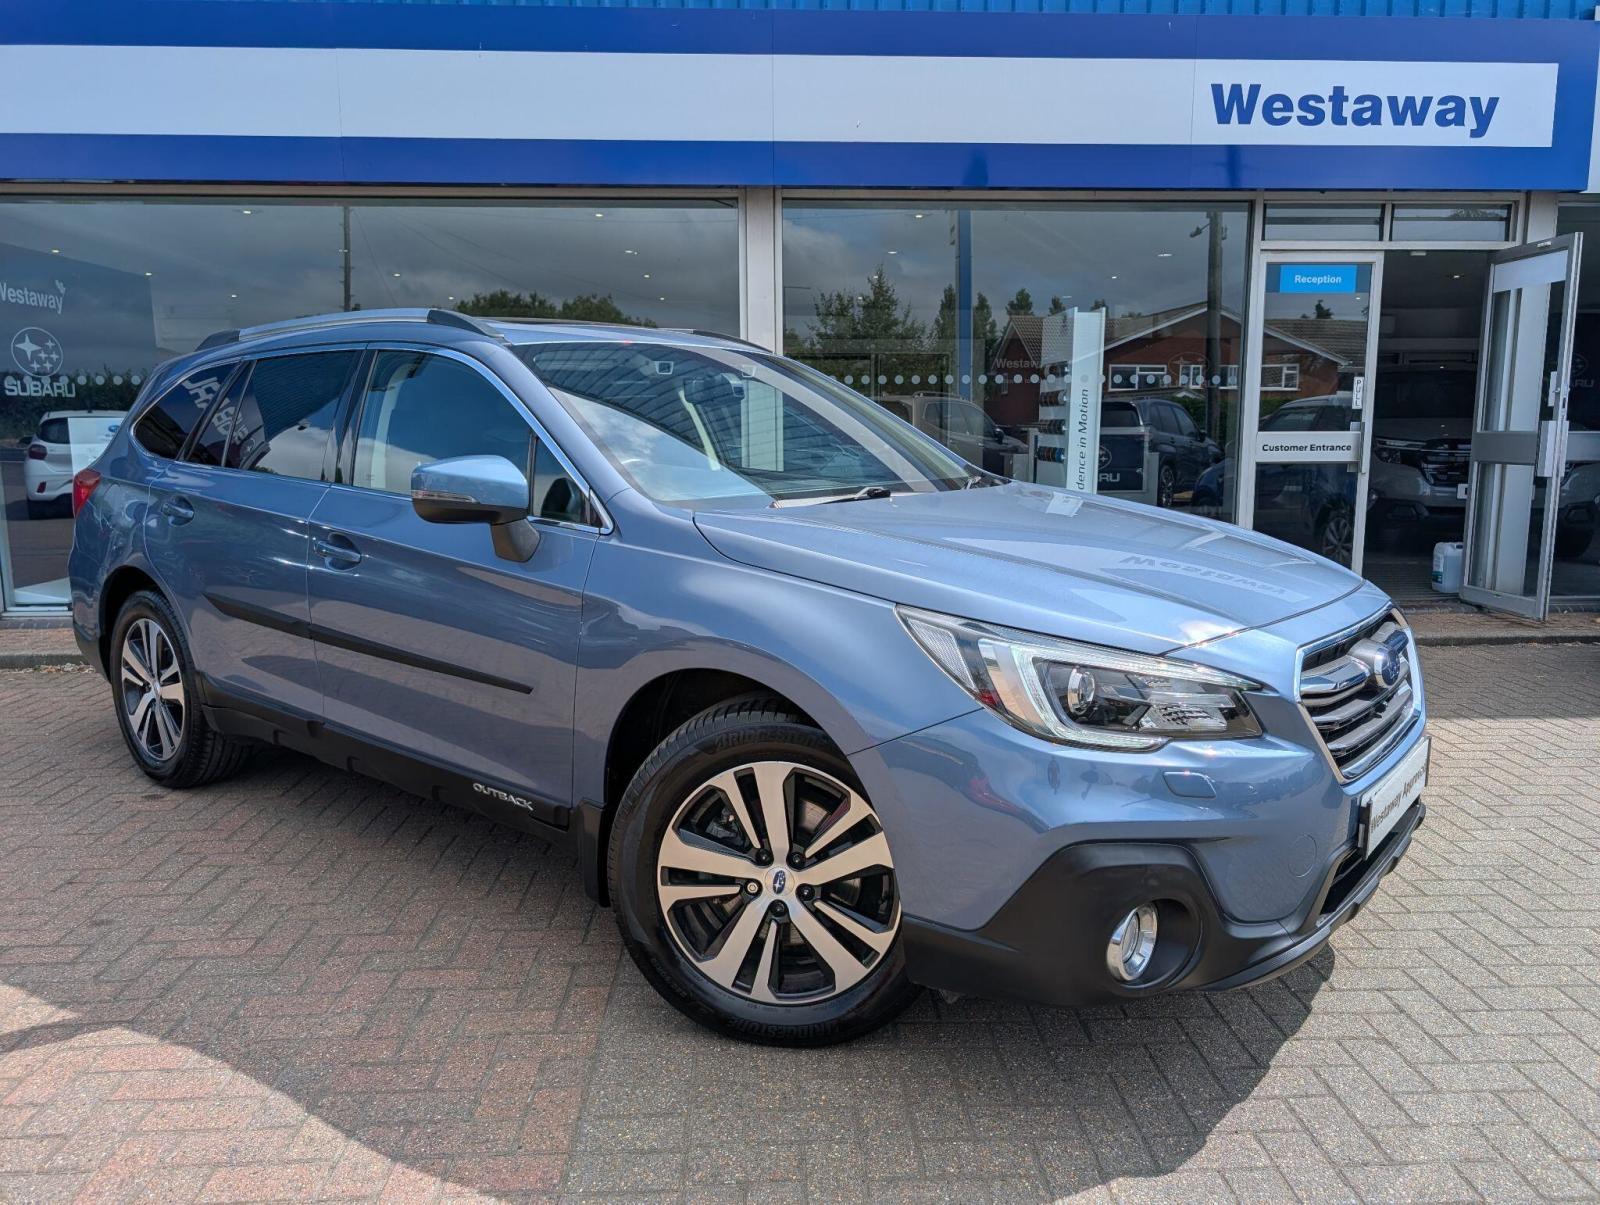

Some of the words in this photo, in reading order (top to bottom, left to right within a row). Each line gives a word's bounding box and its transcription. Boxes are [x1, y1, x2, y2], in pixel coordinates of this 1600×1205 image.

[1210, 83, 1500, 139] Westaway
[1294, 274, 1342, 285] Reception
[996, 358, 1041, 369] Westaw
[4, 378, 76, 398] SUBARU
[1078, 389, 1089, 434] Motion
[1077, 437, 1087, 448] in
[1262, 443, 1308, 452] Customer
[1309, 443, 1352, 452] Entrance
[1075, 451, 1087, 490] dence
[472, 782, 534, 811] OUTBACK
